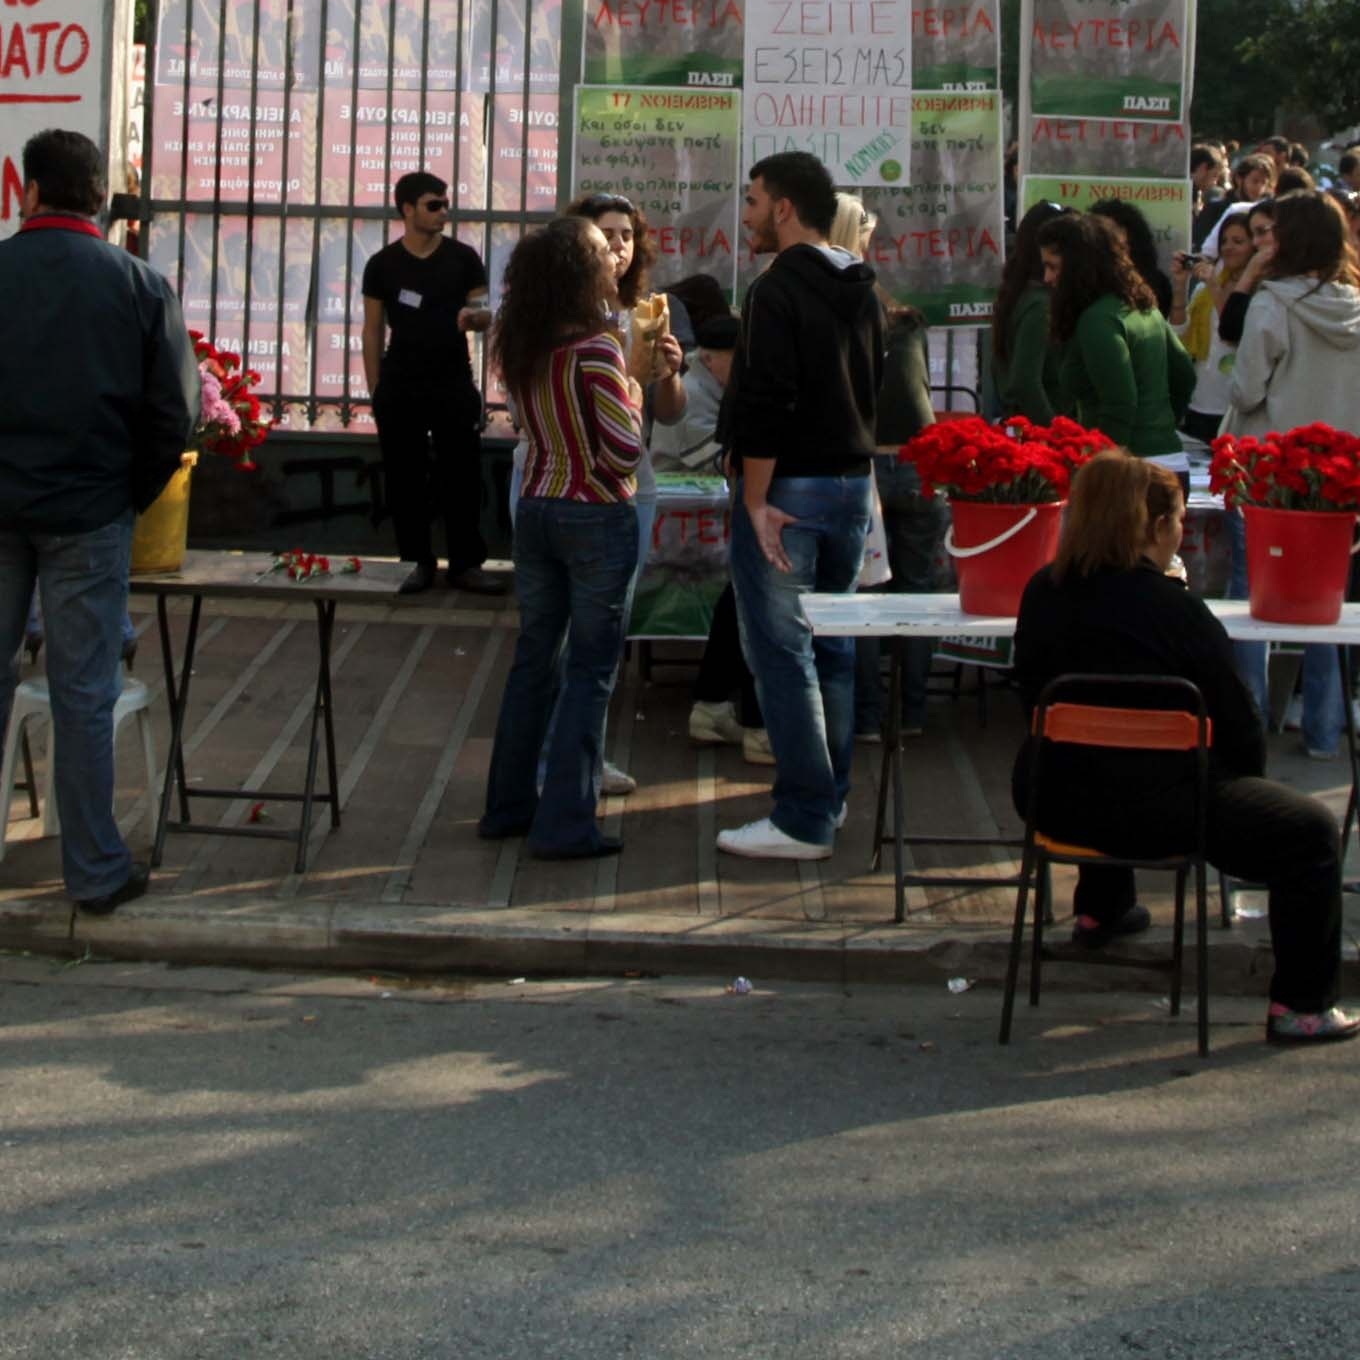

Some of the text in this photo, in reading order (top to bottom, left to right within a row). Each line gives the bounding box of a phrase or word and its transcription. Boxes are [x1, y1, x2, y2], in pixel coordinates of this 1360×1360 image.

[1033, 18, 1180, 53] ΛΕΥΤΕΡΙΑ
[755, 48, 910, 87] ΕΣΕΙΣ ΜΑΣ
[688, 72, 734, 86] ΠΑΣΠ
[612, 92, 631, 108] 17
[911, 97, 995, 111] ΟΕΜΒΡΗ
[1123, 96, 1171, 110] ΠΑΣΠ
[754, 92, 910, 127] ΟΔΗΓΕΙΤΕ
[656, 118, 684, 131] δεν
[1060, 183, 1081, 198] 17
[863, 226, 999, 265] ΕΥΤΕΡΙΑ
